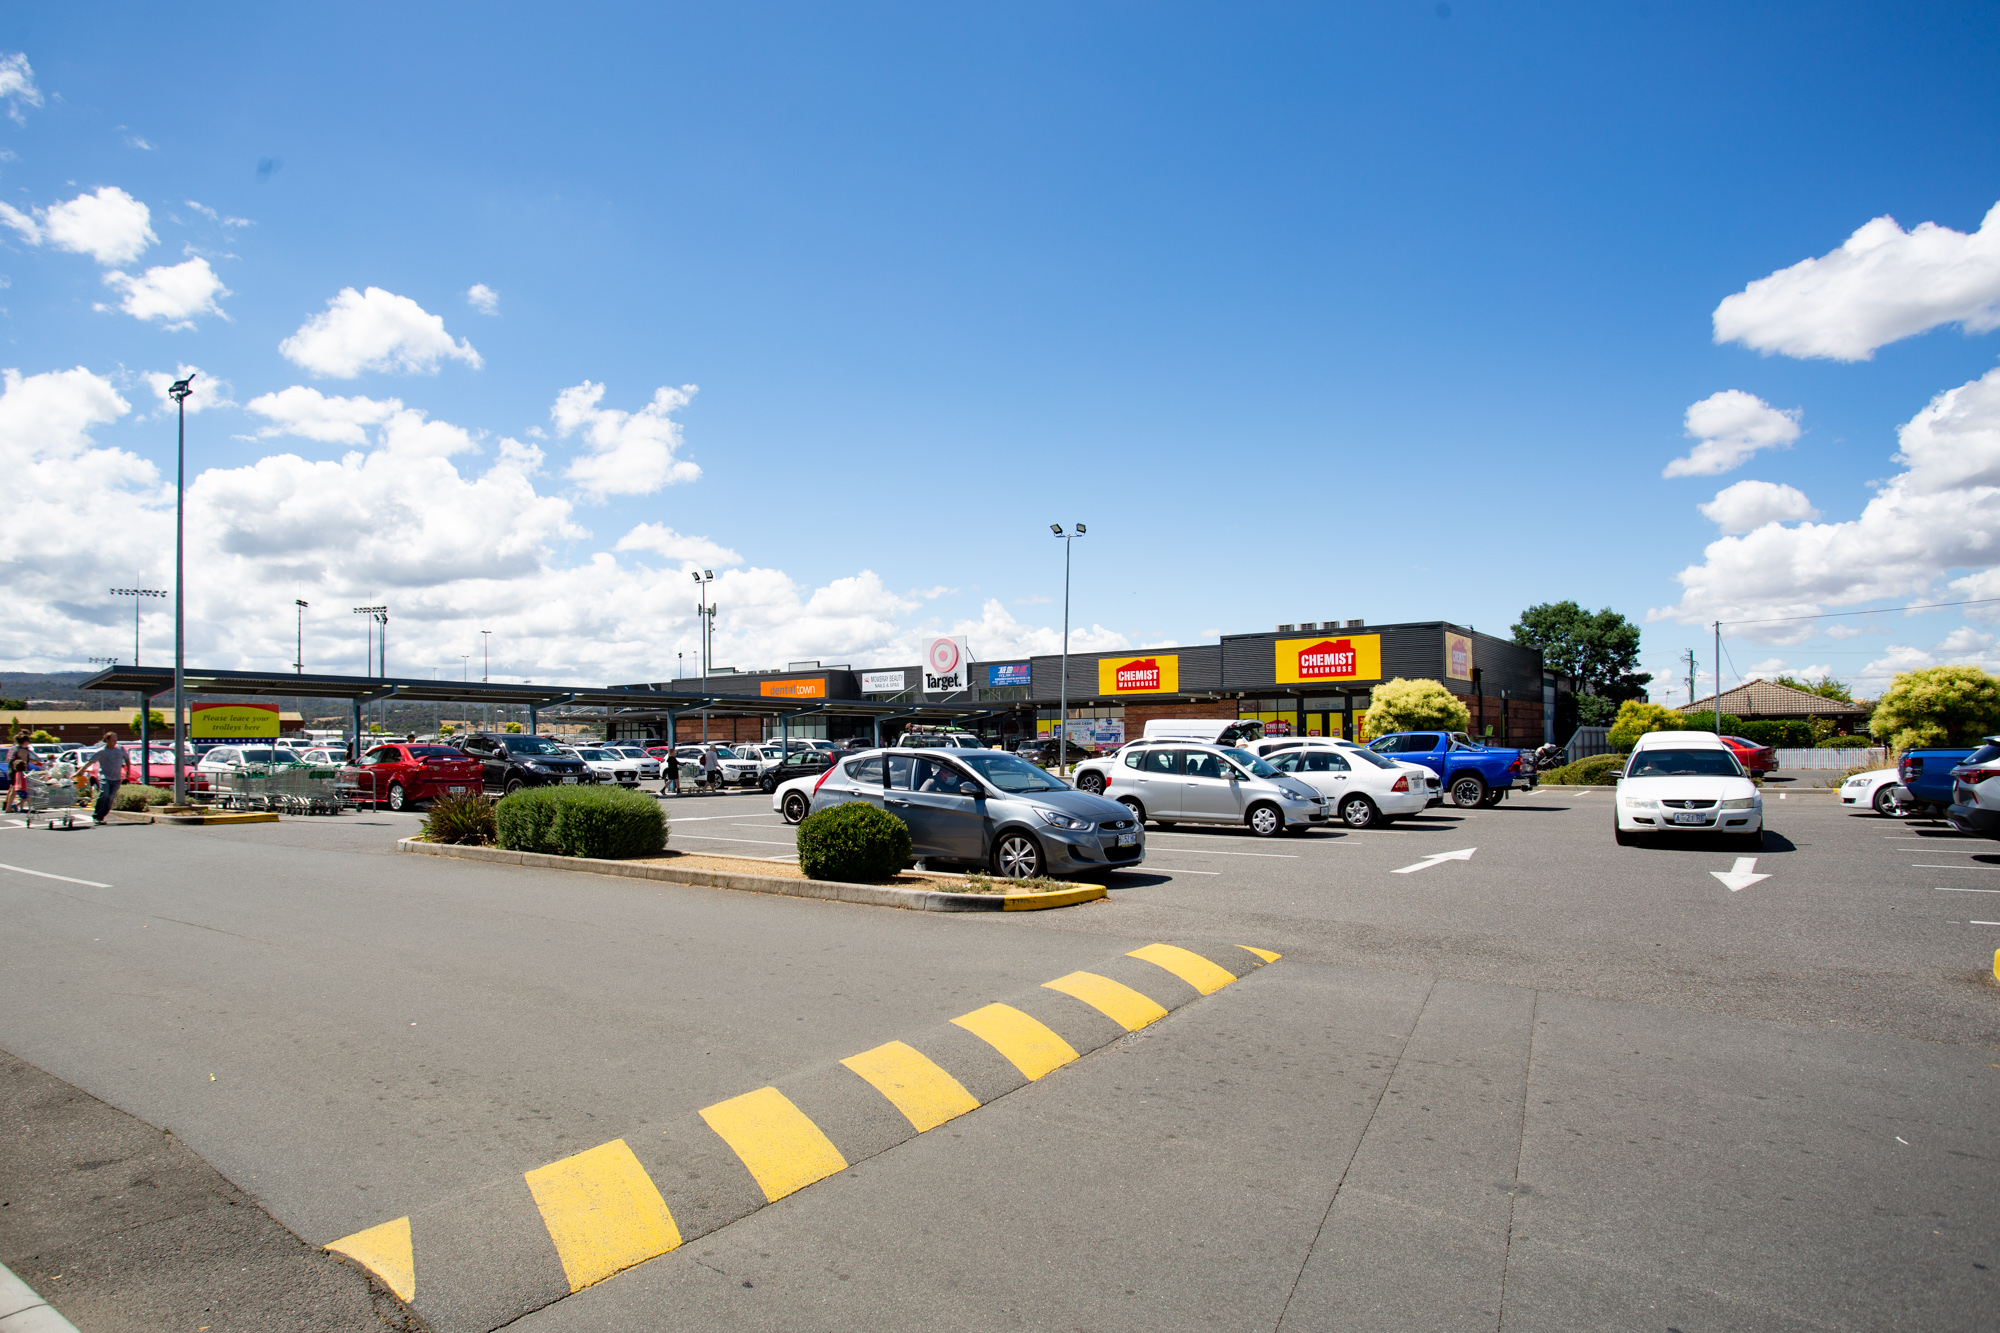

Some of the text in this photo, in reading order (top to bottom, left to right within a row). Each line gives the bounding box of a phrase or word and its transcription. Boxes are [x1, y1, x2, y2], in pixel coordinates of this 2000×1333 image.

[1301, 652, 1354, 667] CHEMIST
[1302, 666, 1352, 674] WAREHOUSE
[889, 674, 904, 682] BEAUTY
[1118, 670, 1158, 681] CHEMIST
[212, 724, 241, 732] trolleys
